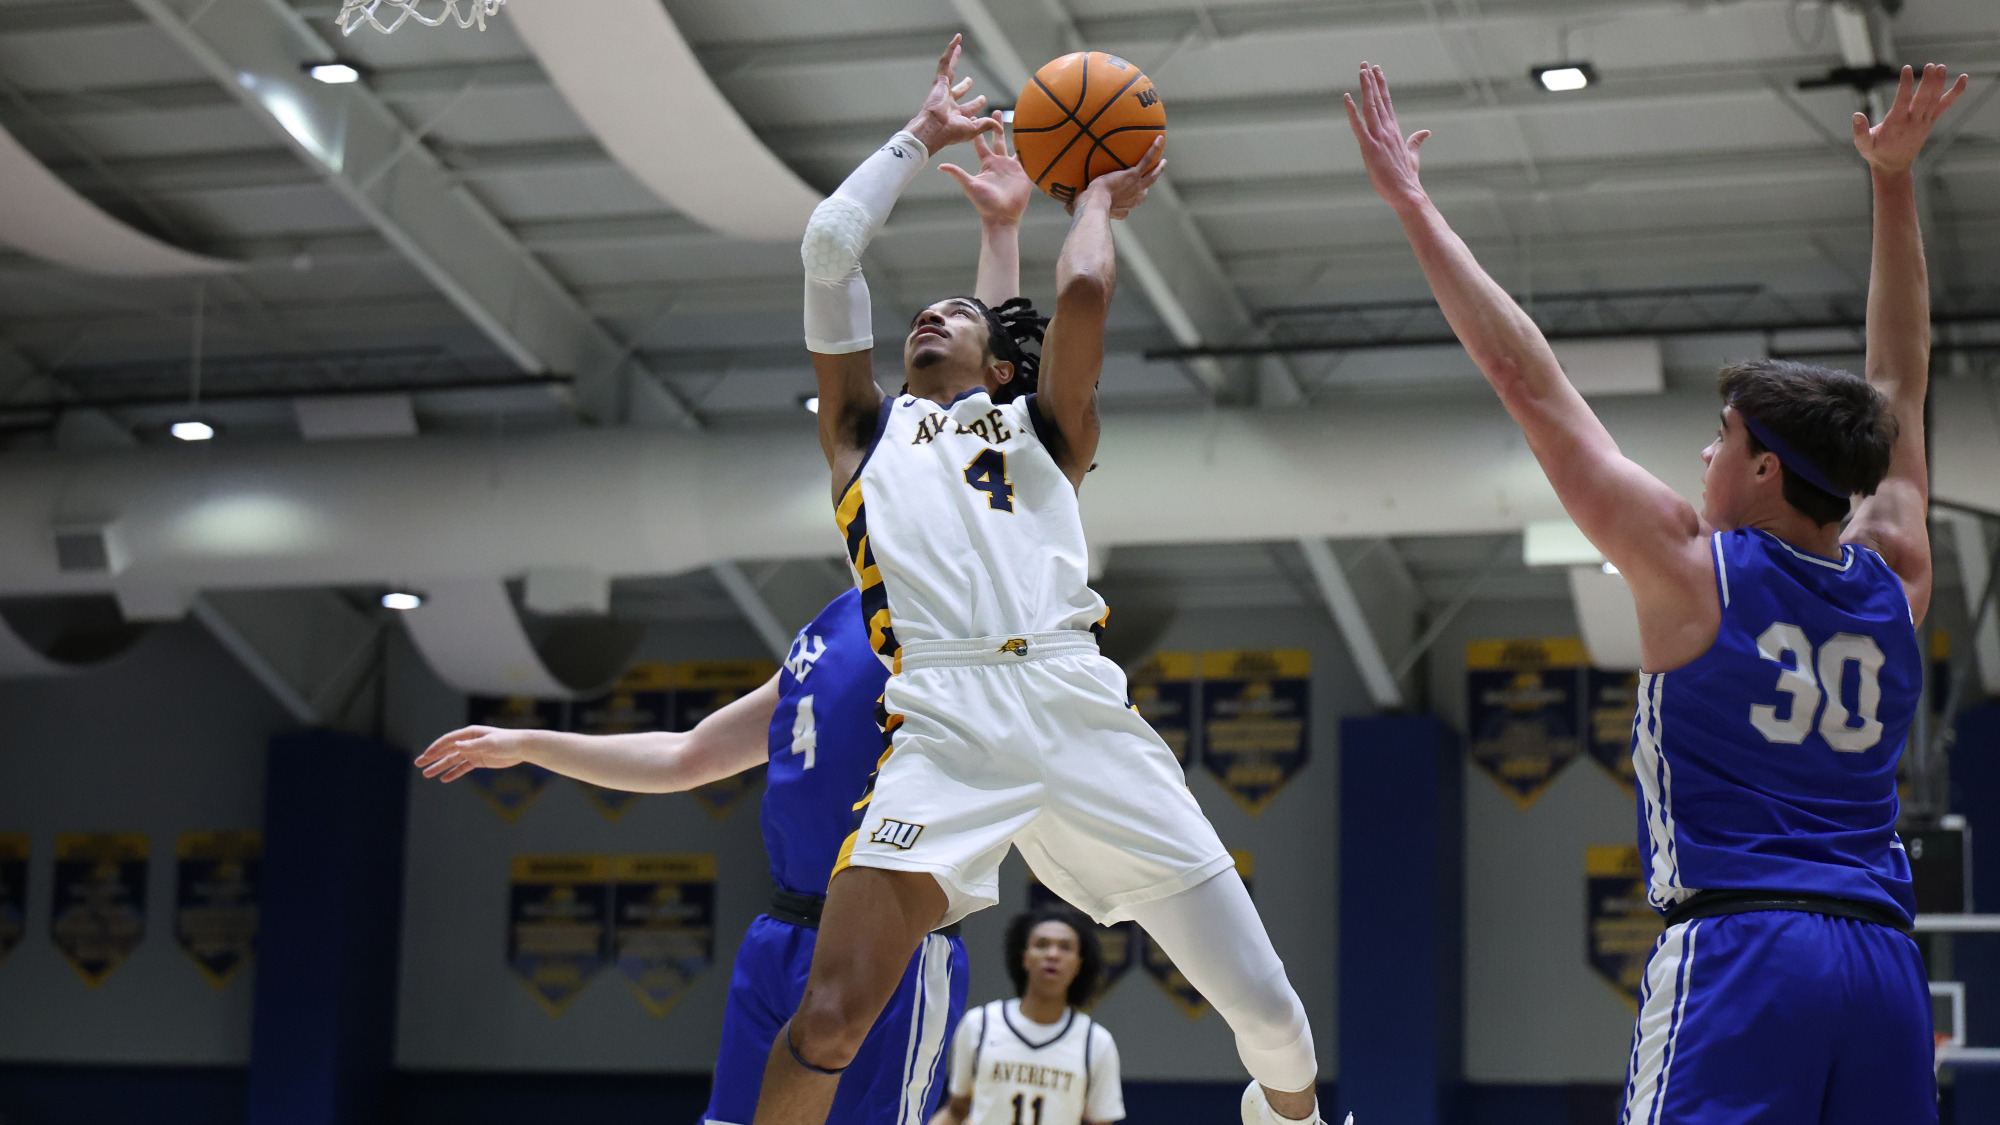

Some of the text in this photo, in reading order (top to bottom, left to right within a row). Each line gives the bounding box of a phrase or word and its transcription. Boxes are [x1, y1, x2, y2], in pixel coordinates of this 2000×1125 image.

[911, 407, 1026, 446] AVRE
[962, 447, 1015, 515] 4
[1750, 621, 1886, 753] 30
[791, 694, 817, 771] 4
[871, 819, 924, 850] AU
[991, 1060, 1076, 1092] AVERETT
[1012, 1092, 1044, 1125] 11
